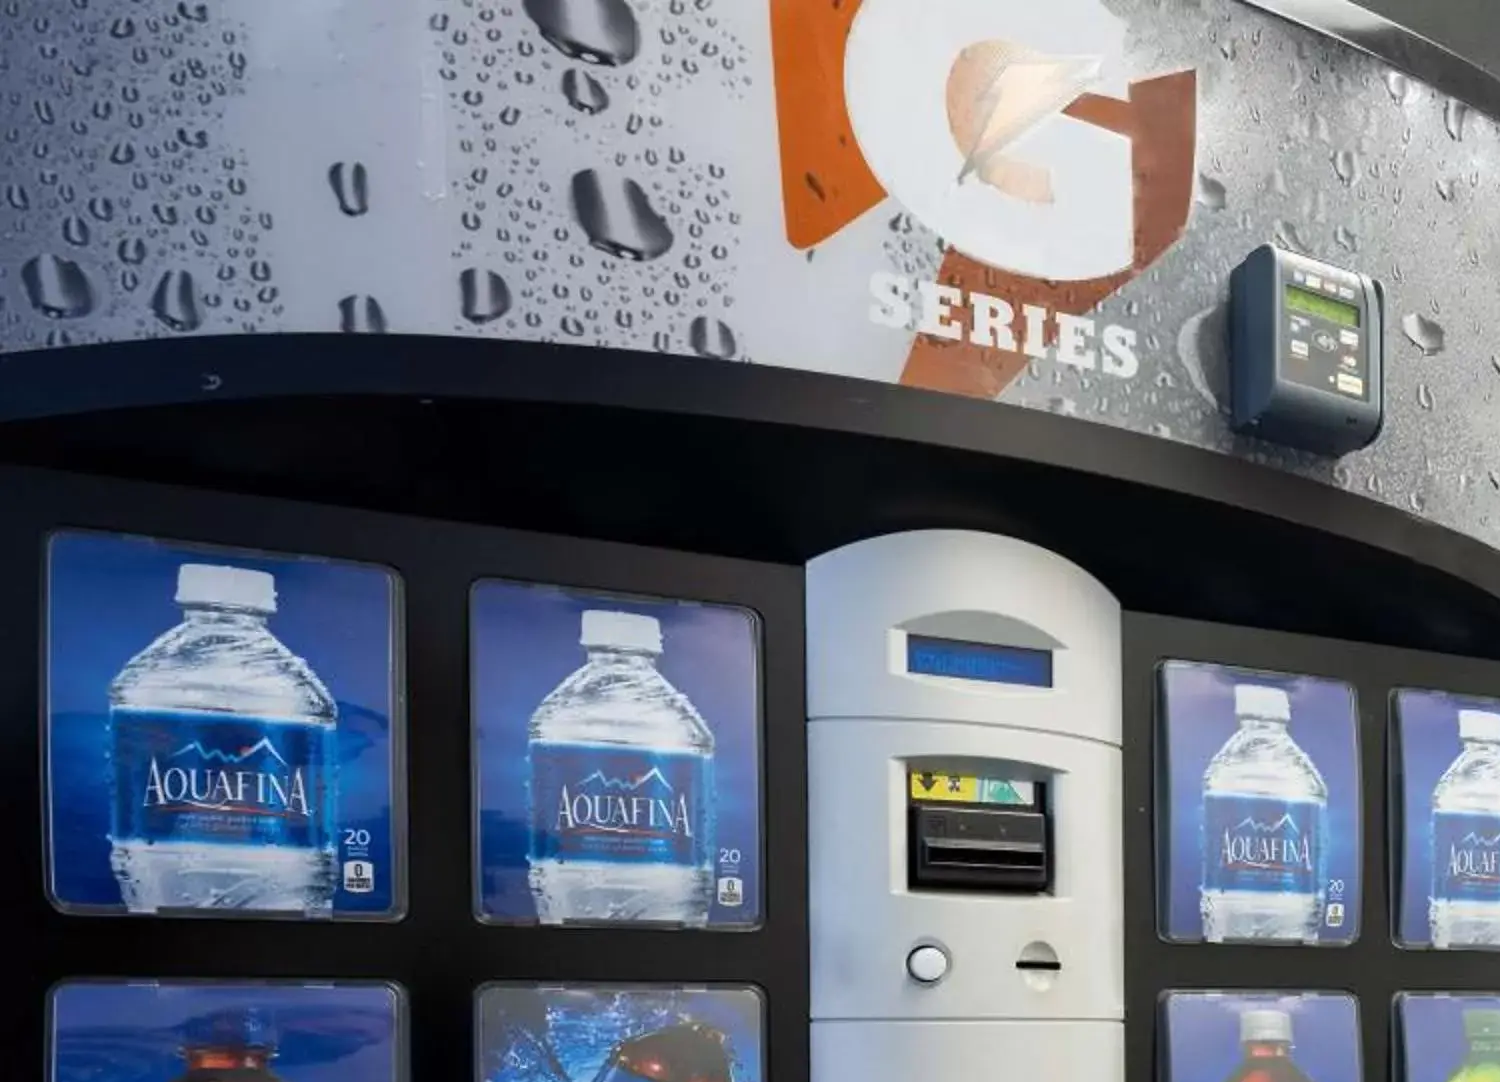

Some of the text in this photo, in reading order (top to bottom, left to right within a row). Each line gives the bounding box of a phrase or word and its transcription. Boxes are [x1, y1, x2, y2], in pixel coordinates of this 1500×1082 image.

[844, 0, 1135, 281] G
[868, 271, 1140, 379] SERIES
[144, 756, 312, 816] AQUAFINA
[556, 784, 694, 837] AQUAFINA
[343, 828, 371, 845] 20
[719, 847, 741, 863] 20
[1221, 827, 1312, 872] AQUAFINA
[354, 863, 363, 877] 0
[1328, 879, 1345, 893] 20
